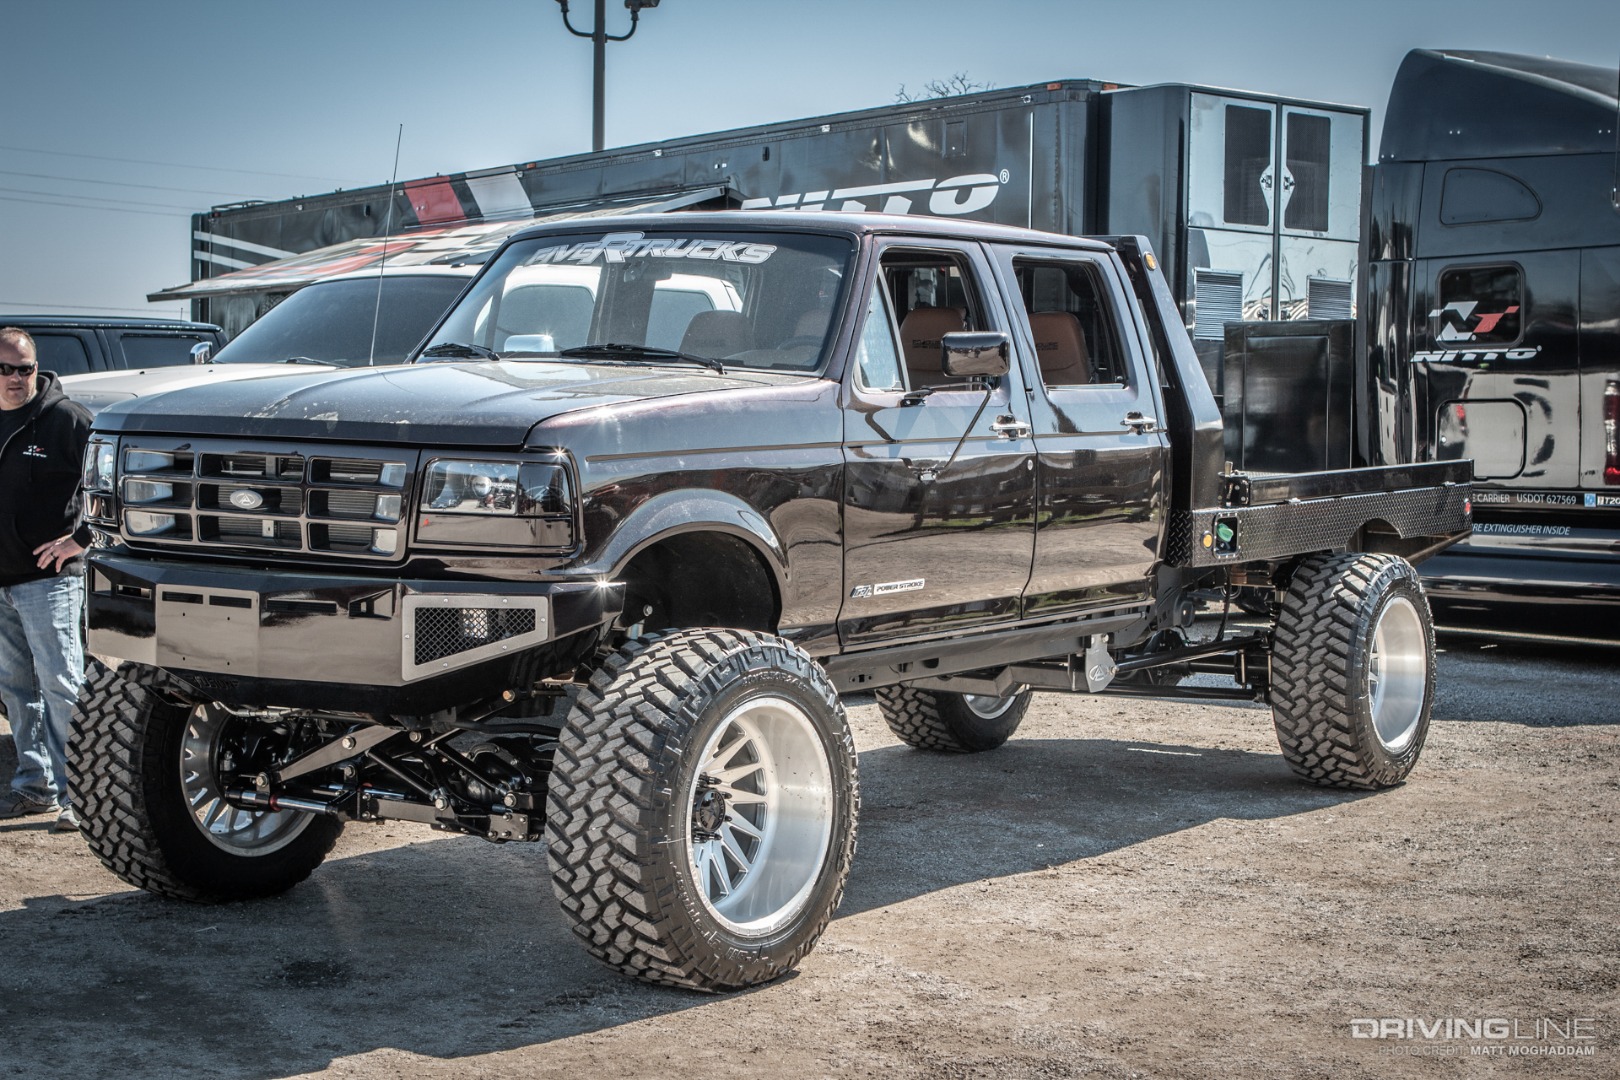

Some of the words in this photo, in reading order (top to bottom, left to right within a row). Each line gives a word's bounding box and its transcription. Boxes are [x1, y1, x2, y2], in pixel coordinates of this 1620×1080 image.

[1410, 348, 1538, 363] NITTO
[1477, 493, 1511, 503] CARRIER
[1516, 493, 1545, 504] USDOT
[1546, 494, 1577, 505] 627569
[1471, 523, 1483, 532] RE
[1484, 523, 1542, 534] EXTINGUISHER
[1542, 526, 1571, 536] INSIDE
